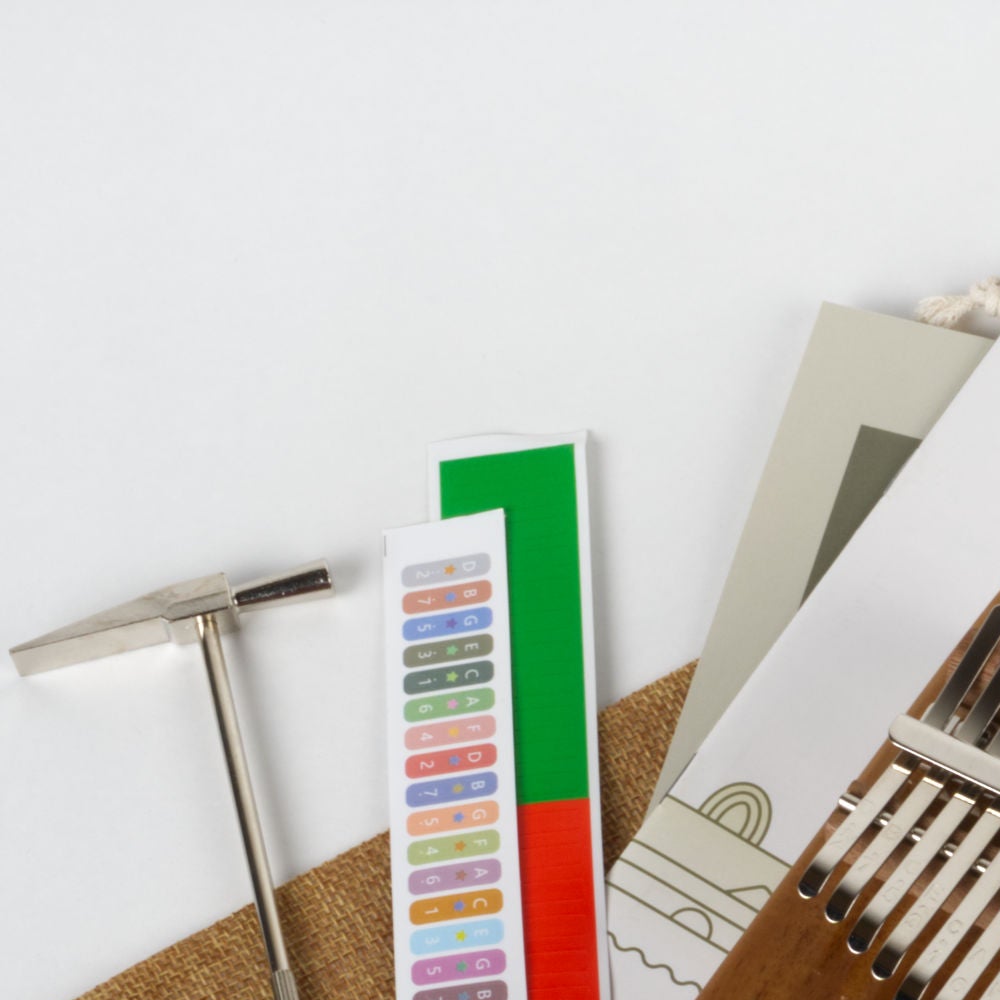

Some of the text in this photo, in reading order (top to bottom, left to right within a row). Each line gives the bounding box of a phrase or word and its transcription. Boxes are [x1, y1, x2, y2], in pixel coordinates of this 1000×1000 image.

[464, 589, 477, 598] B
[464, 616, 478, 626] G
[464, 643, 479, 651] E
[465, 669, 479, 679] C
[466, 696, 480, 707] A
[467, 724, 480, 732] F
[467, 752, 482, 762] D
[471, 780, 485, 790] B
[472, 808, 486, 820] G
[474, 868, 488, 878] A
[473, 898, 488, 909] C
[476, 958, 490, 970] G
[476, 989, 492, 1000] B
